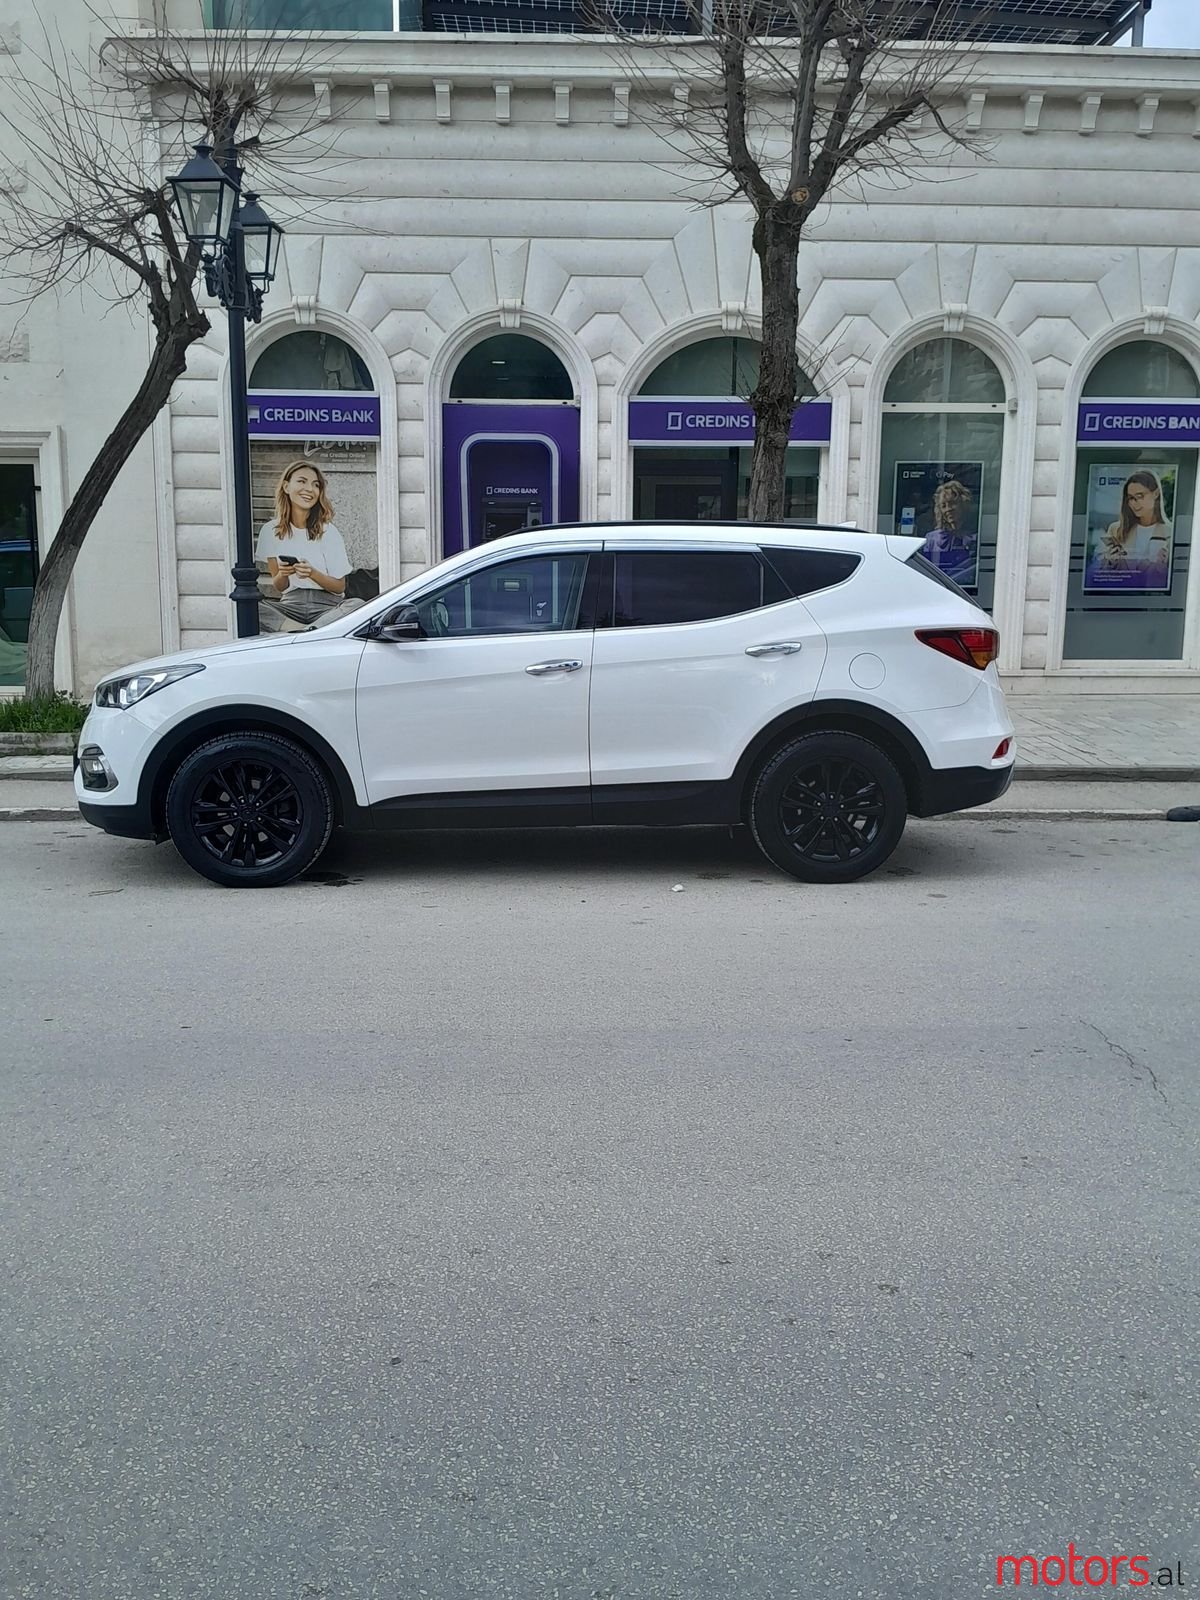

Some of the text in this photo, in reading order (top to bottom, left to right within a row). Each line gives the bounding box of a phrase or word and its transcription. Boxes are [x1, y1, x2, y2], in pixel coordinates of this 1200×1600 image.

[263, 408, 374, 423] CREDINS BANK
[685, 415, 750, 428] CREDINS
[1102, 415, 1167, 429] CREDINS
